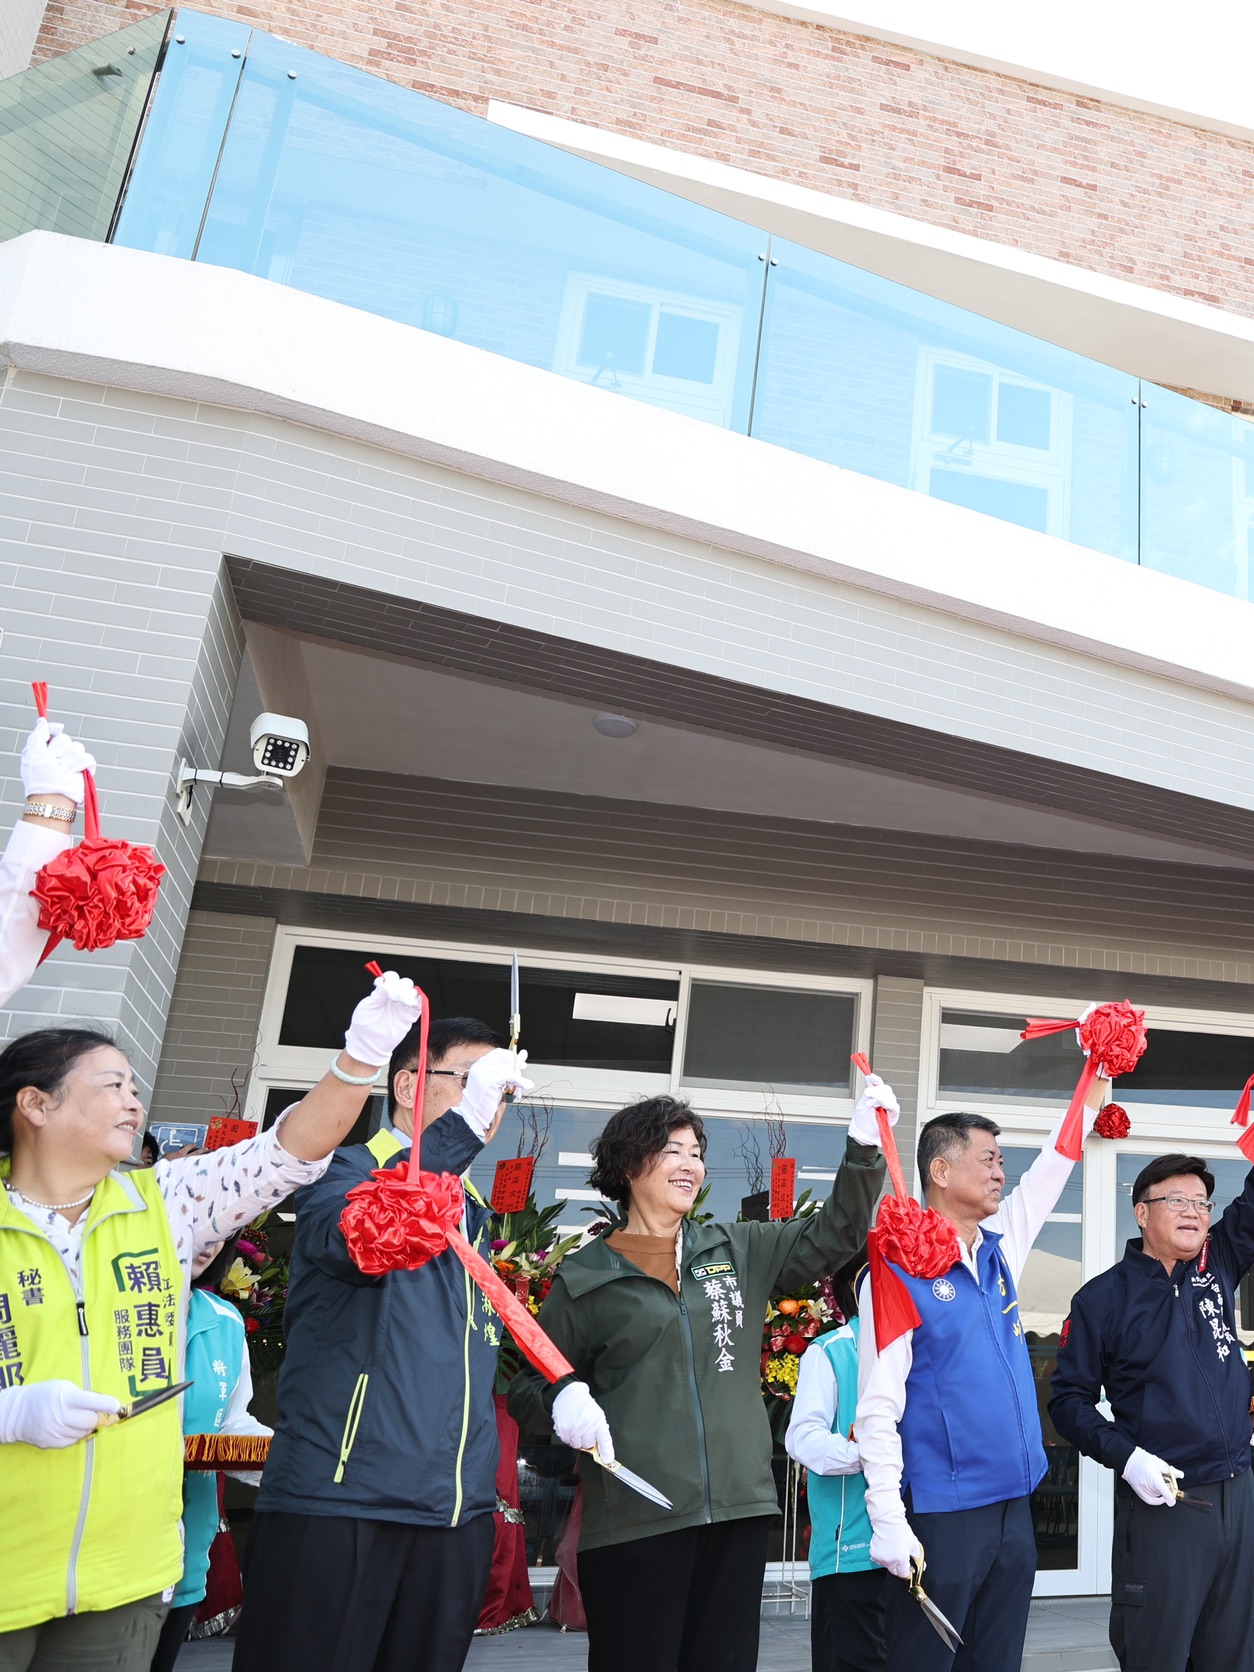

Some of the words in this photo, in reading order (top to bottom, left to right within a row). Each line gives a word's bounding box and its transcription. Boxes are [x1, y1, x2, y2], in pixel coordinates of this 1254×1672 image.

[17, 1267, 45, 1307] 秘書
[704, 1263, 732, 1275] DPP
[124, 1260, 169, 1383] 賴惠員
[703, 1278, 736, 1373] 蔡蘇秋金
[722, 1275, 745, 1329] 市議員
[1198, 1297, 1231, 1363] 陳昆和
[114, 1308, 136, 1373] 服務團隊
